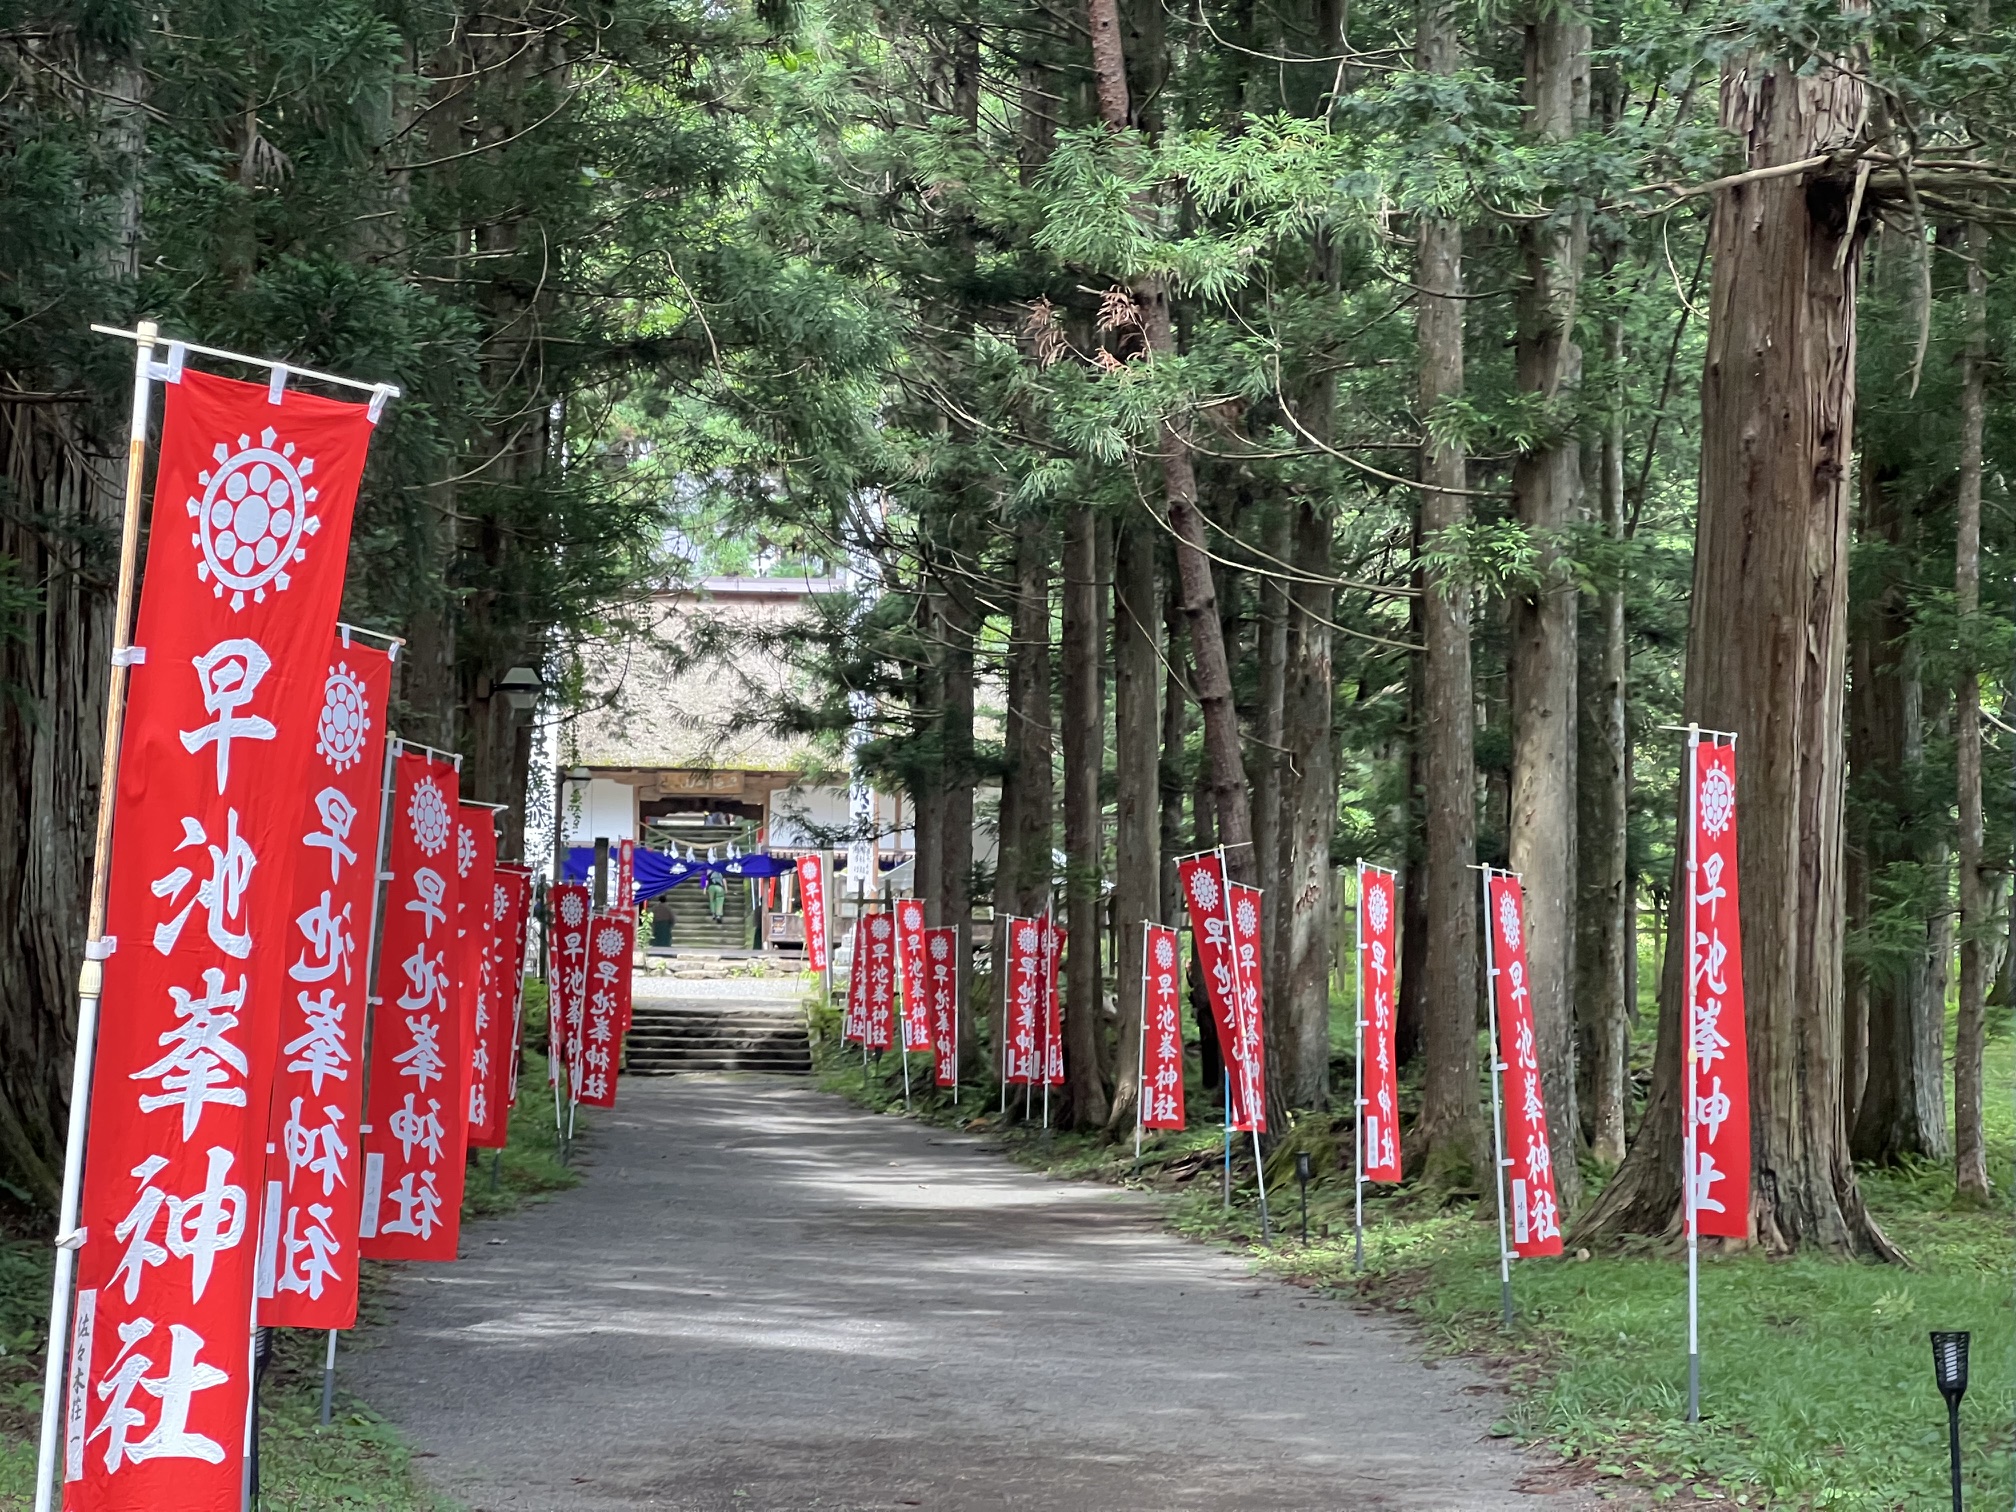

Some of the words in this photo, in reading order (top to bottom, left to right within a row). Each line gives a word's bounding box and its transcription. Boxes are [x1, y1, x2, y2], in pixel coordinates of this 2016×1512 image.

[805, 882, 826, 968] 早池峯神社
[906, 934, 929, 1045] 早池峯神社
[86, 637, 277, 1474] 早池峯神社
[871, 943, 890, 1045] 早池峯神社
[1153, 973, 1179, 1122] 早池峯神社
[1509, 960, 1561, 1243] 早池峯神社
